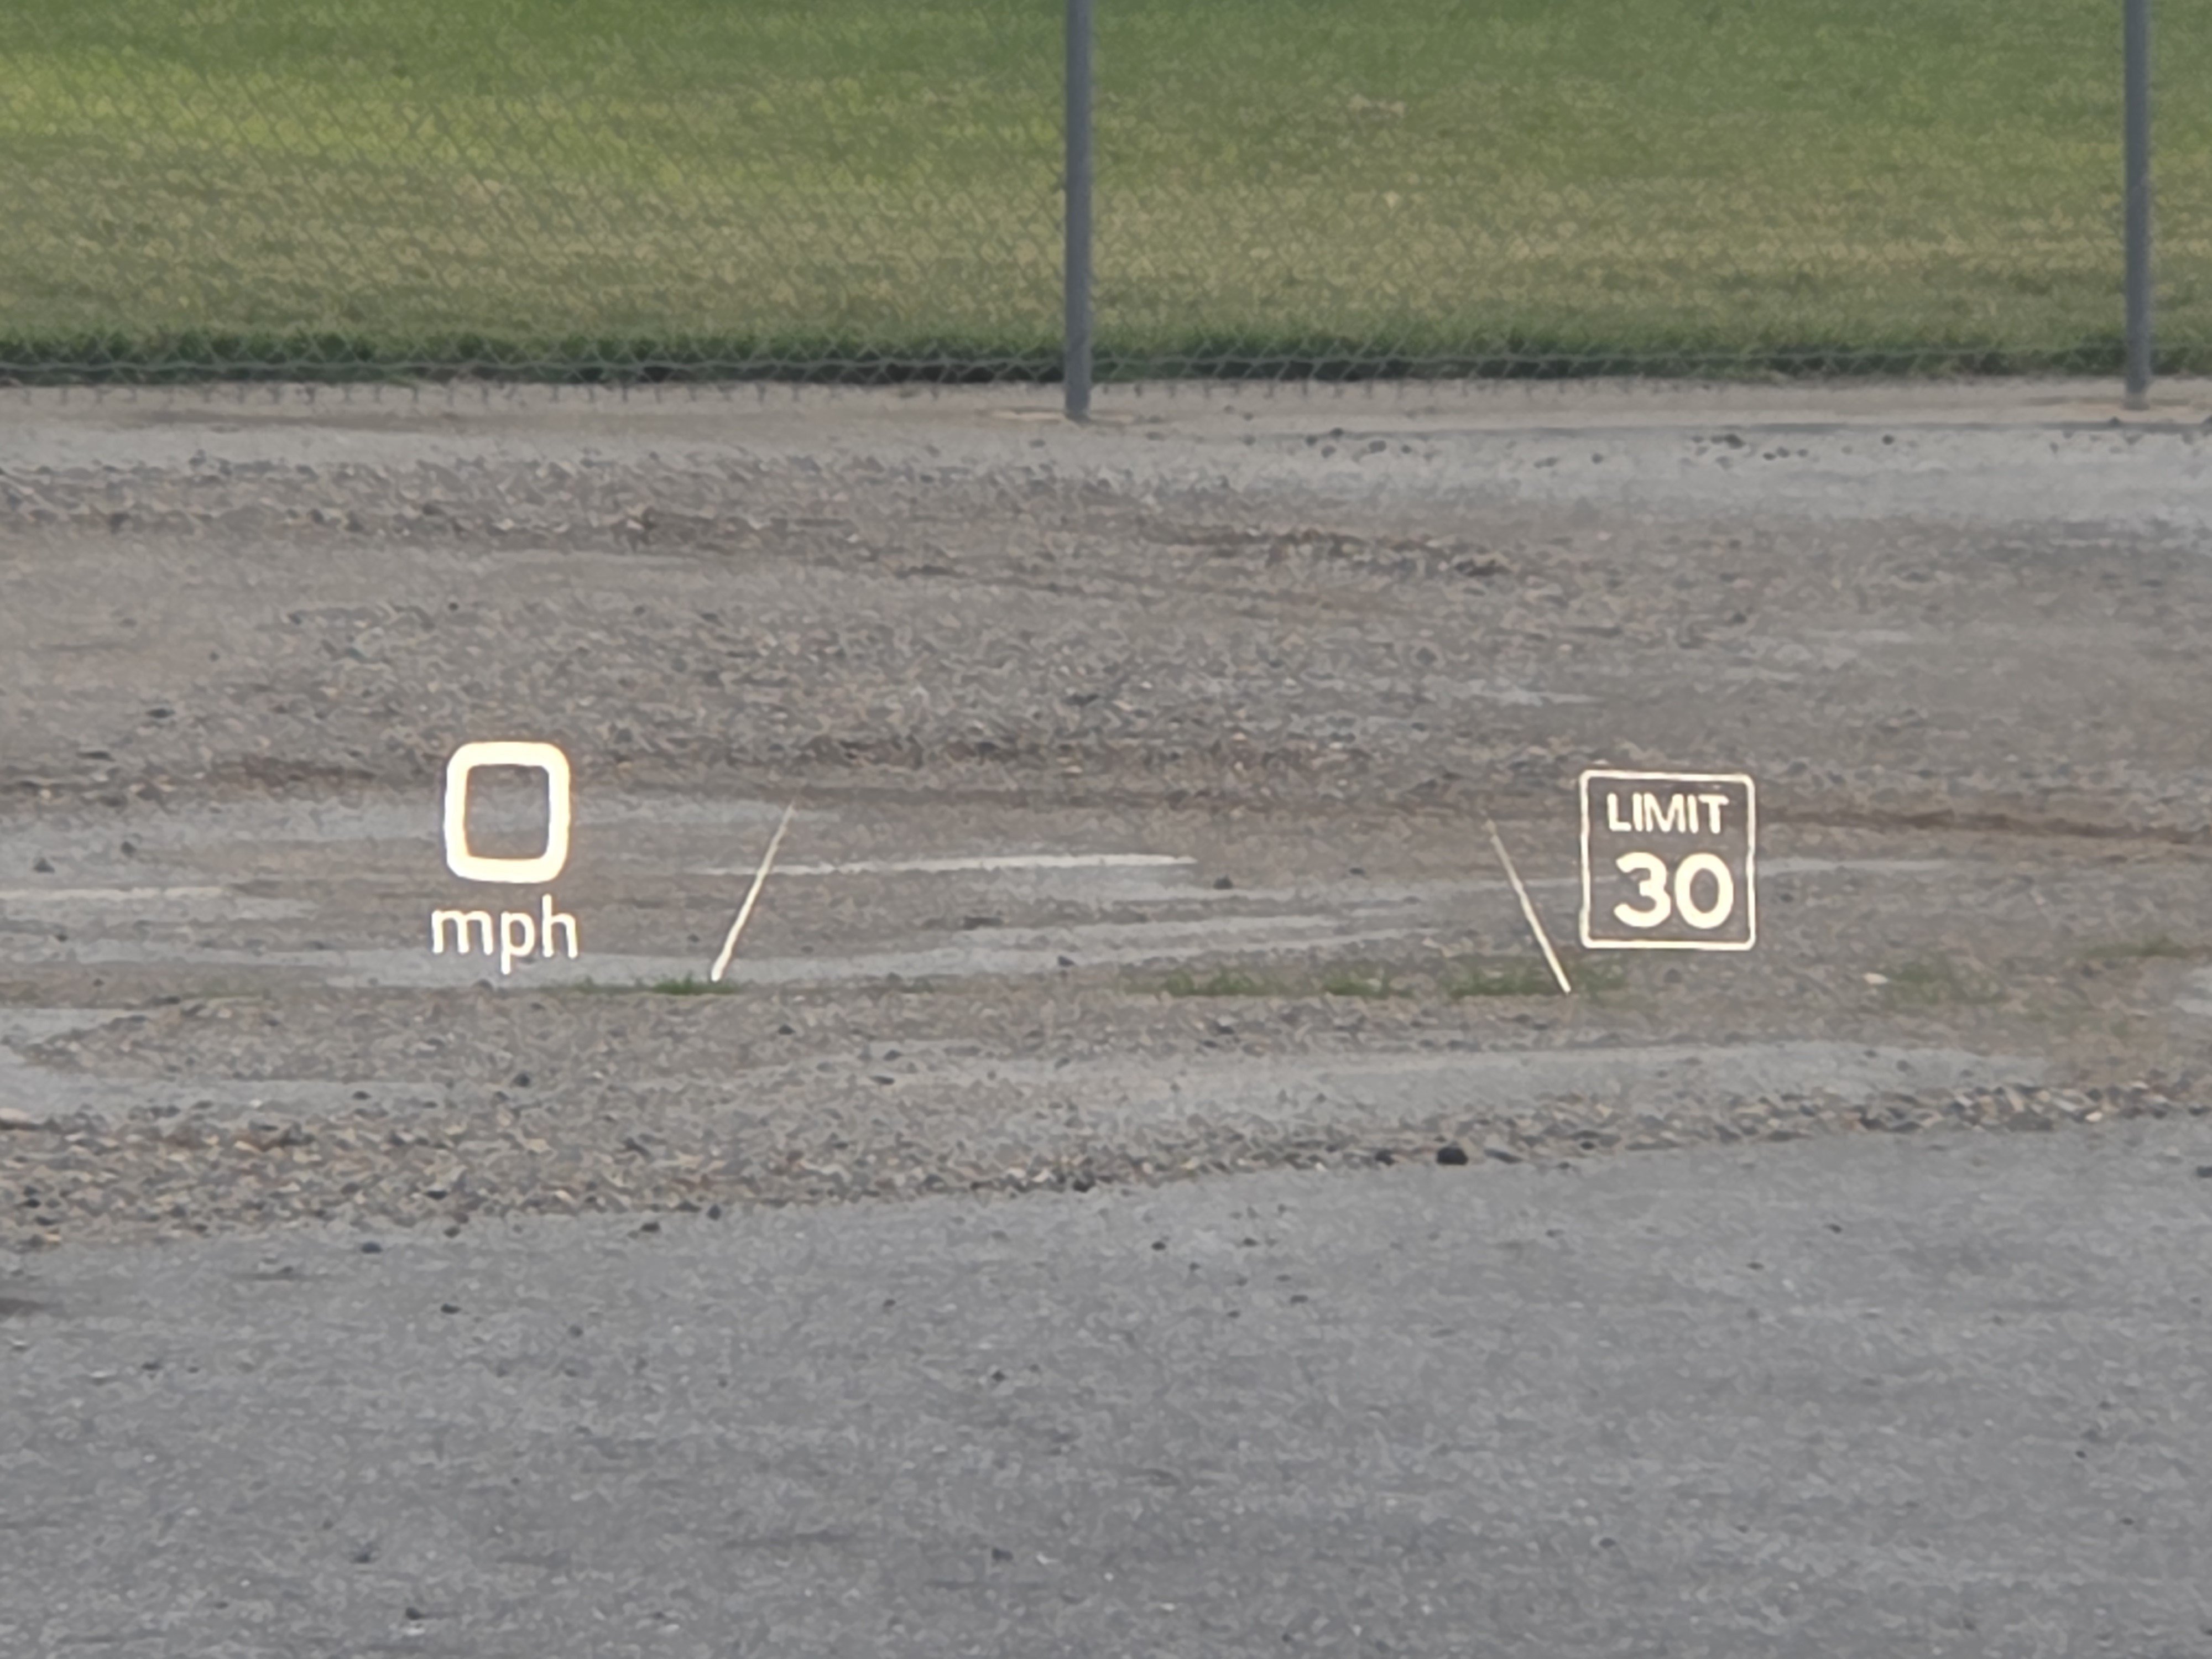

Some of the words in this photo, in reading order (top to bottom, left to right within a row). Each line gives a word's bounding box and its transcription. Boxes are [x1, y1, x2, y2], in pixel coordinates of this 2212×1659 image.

[444, 741, 571, 884] 0
[1606, 792, 1730, 834] LIMIT
[1614, 852, 1734, 929] 30
[431, 894, 578, 975] mph
